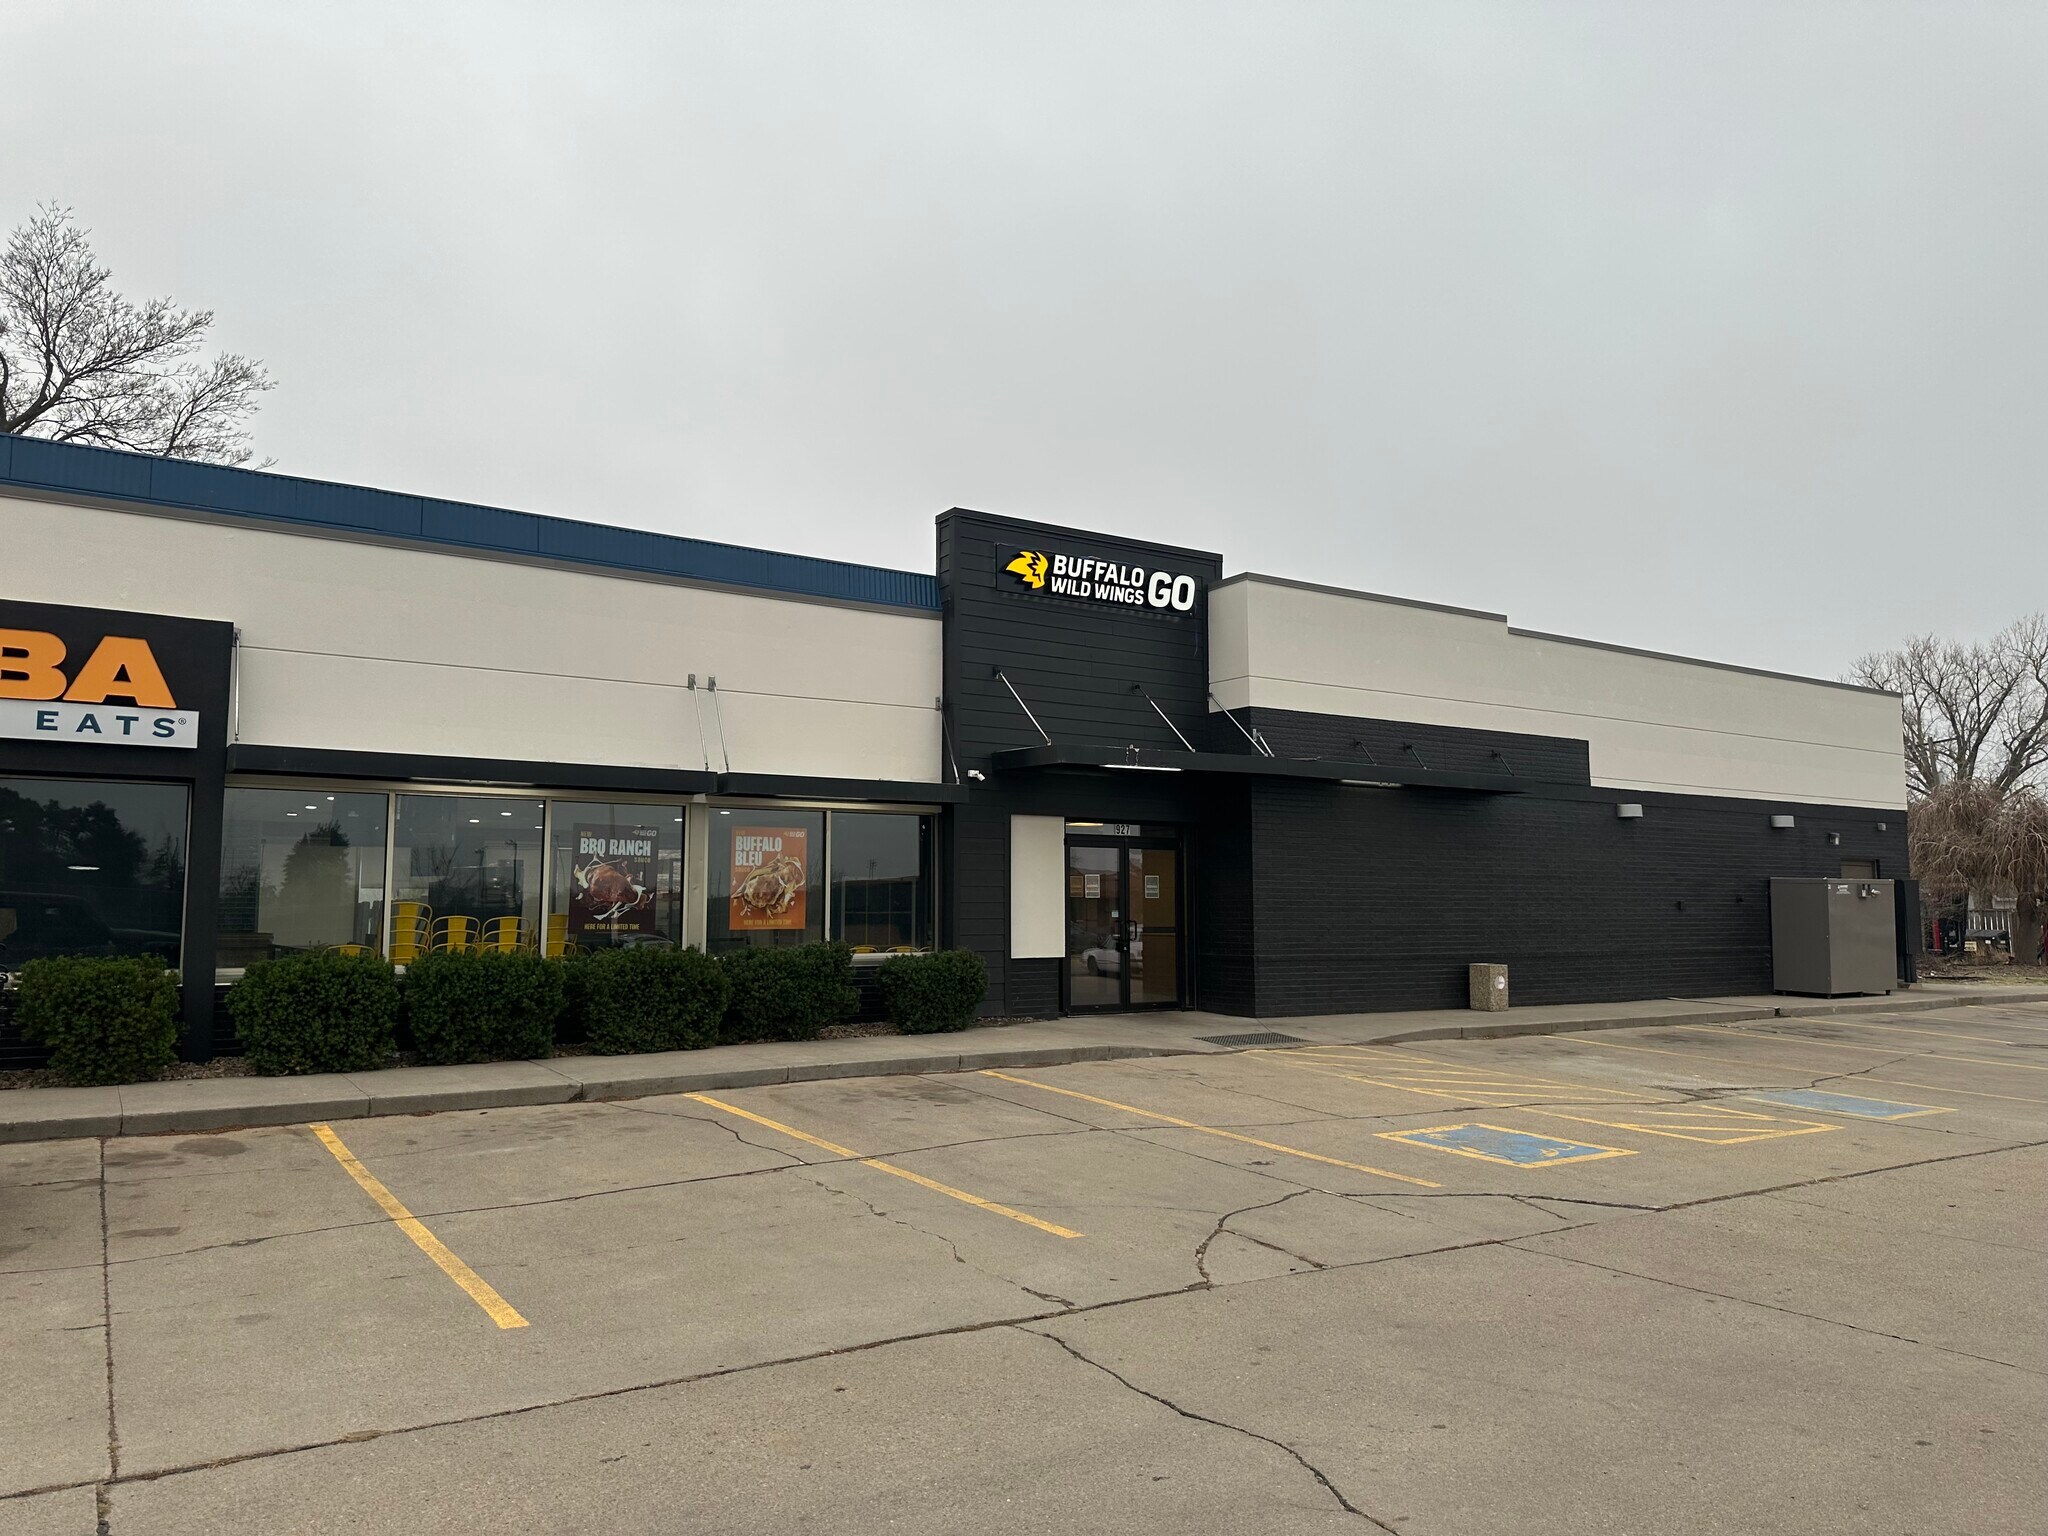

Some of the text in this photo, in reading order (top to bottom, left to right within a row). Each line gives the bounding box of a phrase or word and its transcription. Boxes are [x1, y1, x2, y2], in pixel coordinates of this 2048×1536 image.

[1051, 577, 1144, 605] WILD WINGS
[1052, 554, 1195, 611] BUFFALO GO
[580, 838, 651, 857] BBQ RANCH
[735, 836, 782, 852] BUFFALO
[735, 851, 763, 867] BLEU
